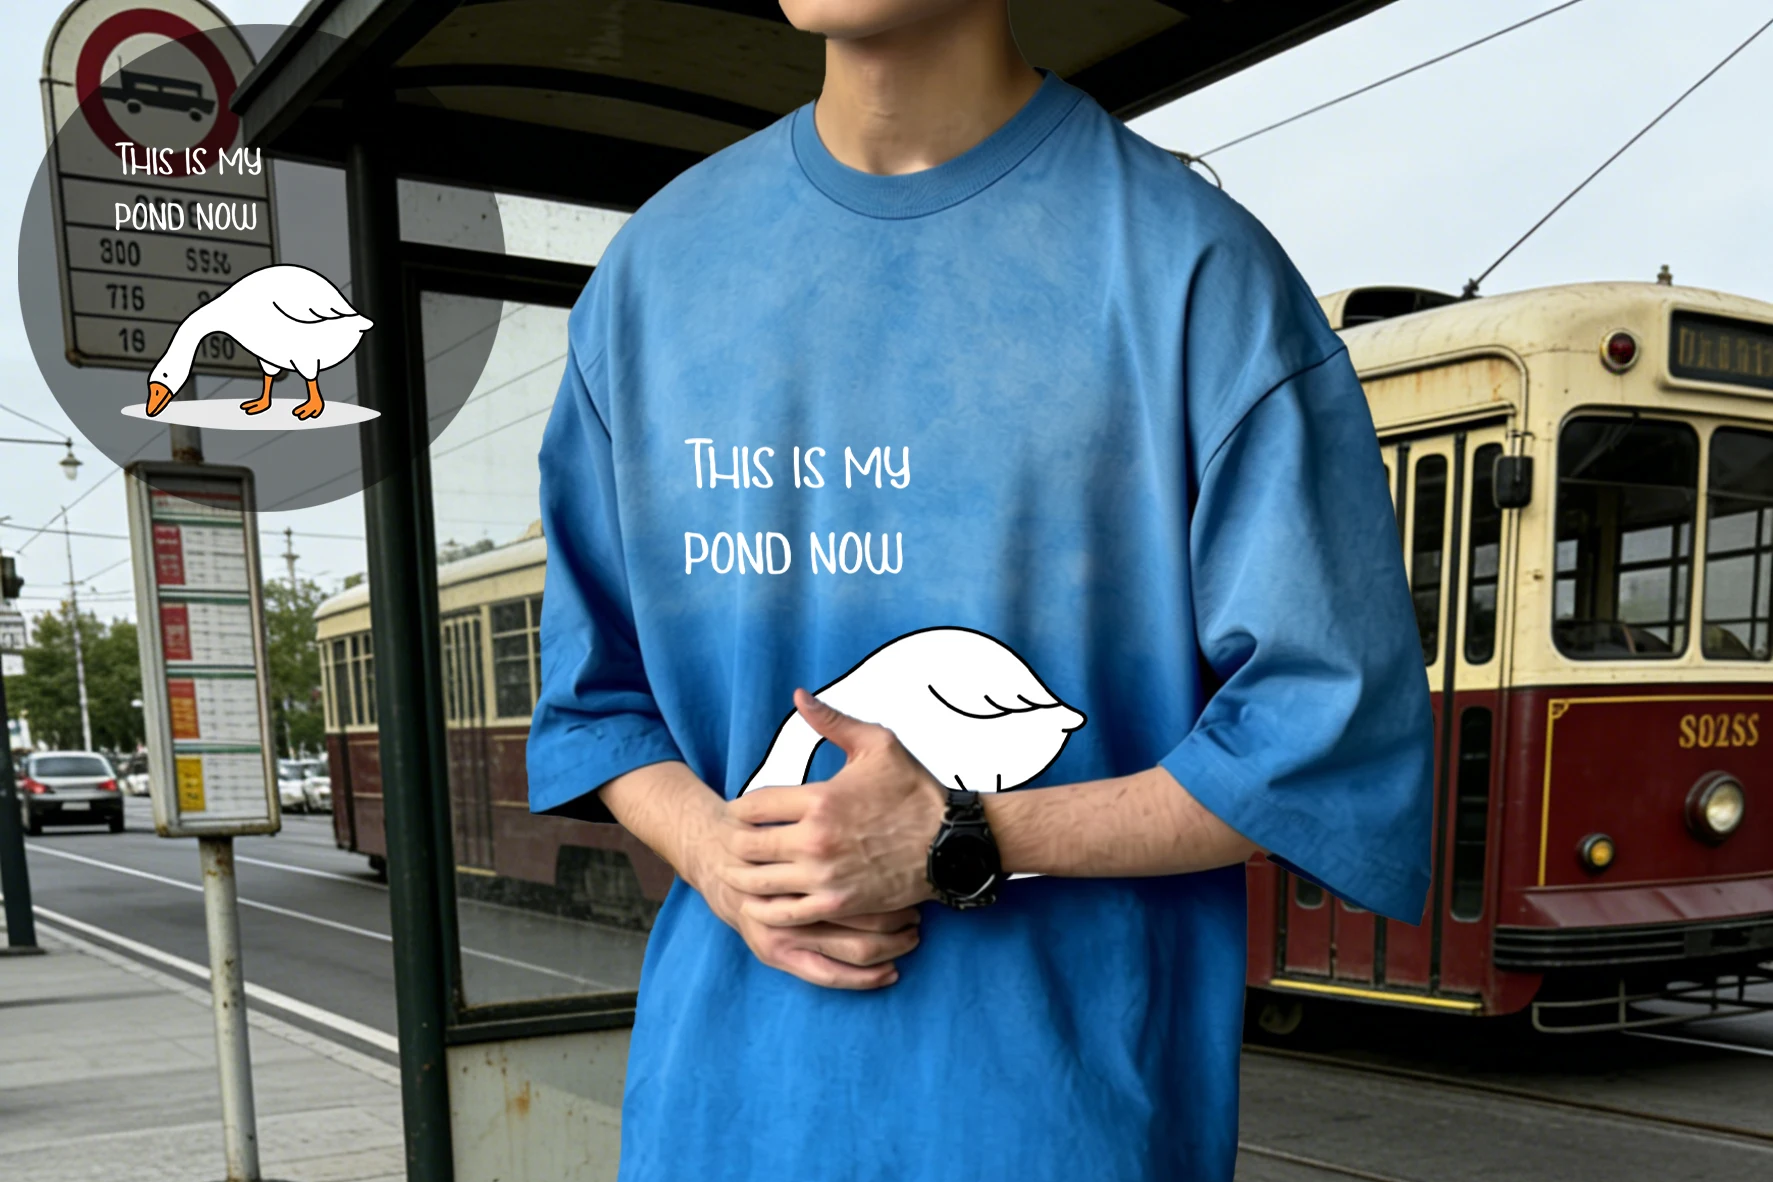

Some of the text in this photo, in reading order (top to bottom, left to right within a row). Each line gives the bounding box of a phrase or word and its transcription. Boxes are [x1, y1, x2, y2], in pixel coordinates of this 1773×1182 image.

[685, 438, 911, 489] THIS IS MY
[684, 531, 903, 575] POND NOW
